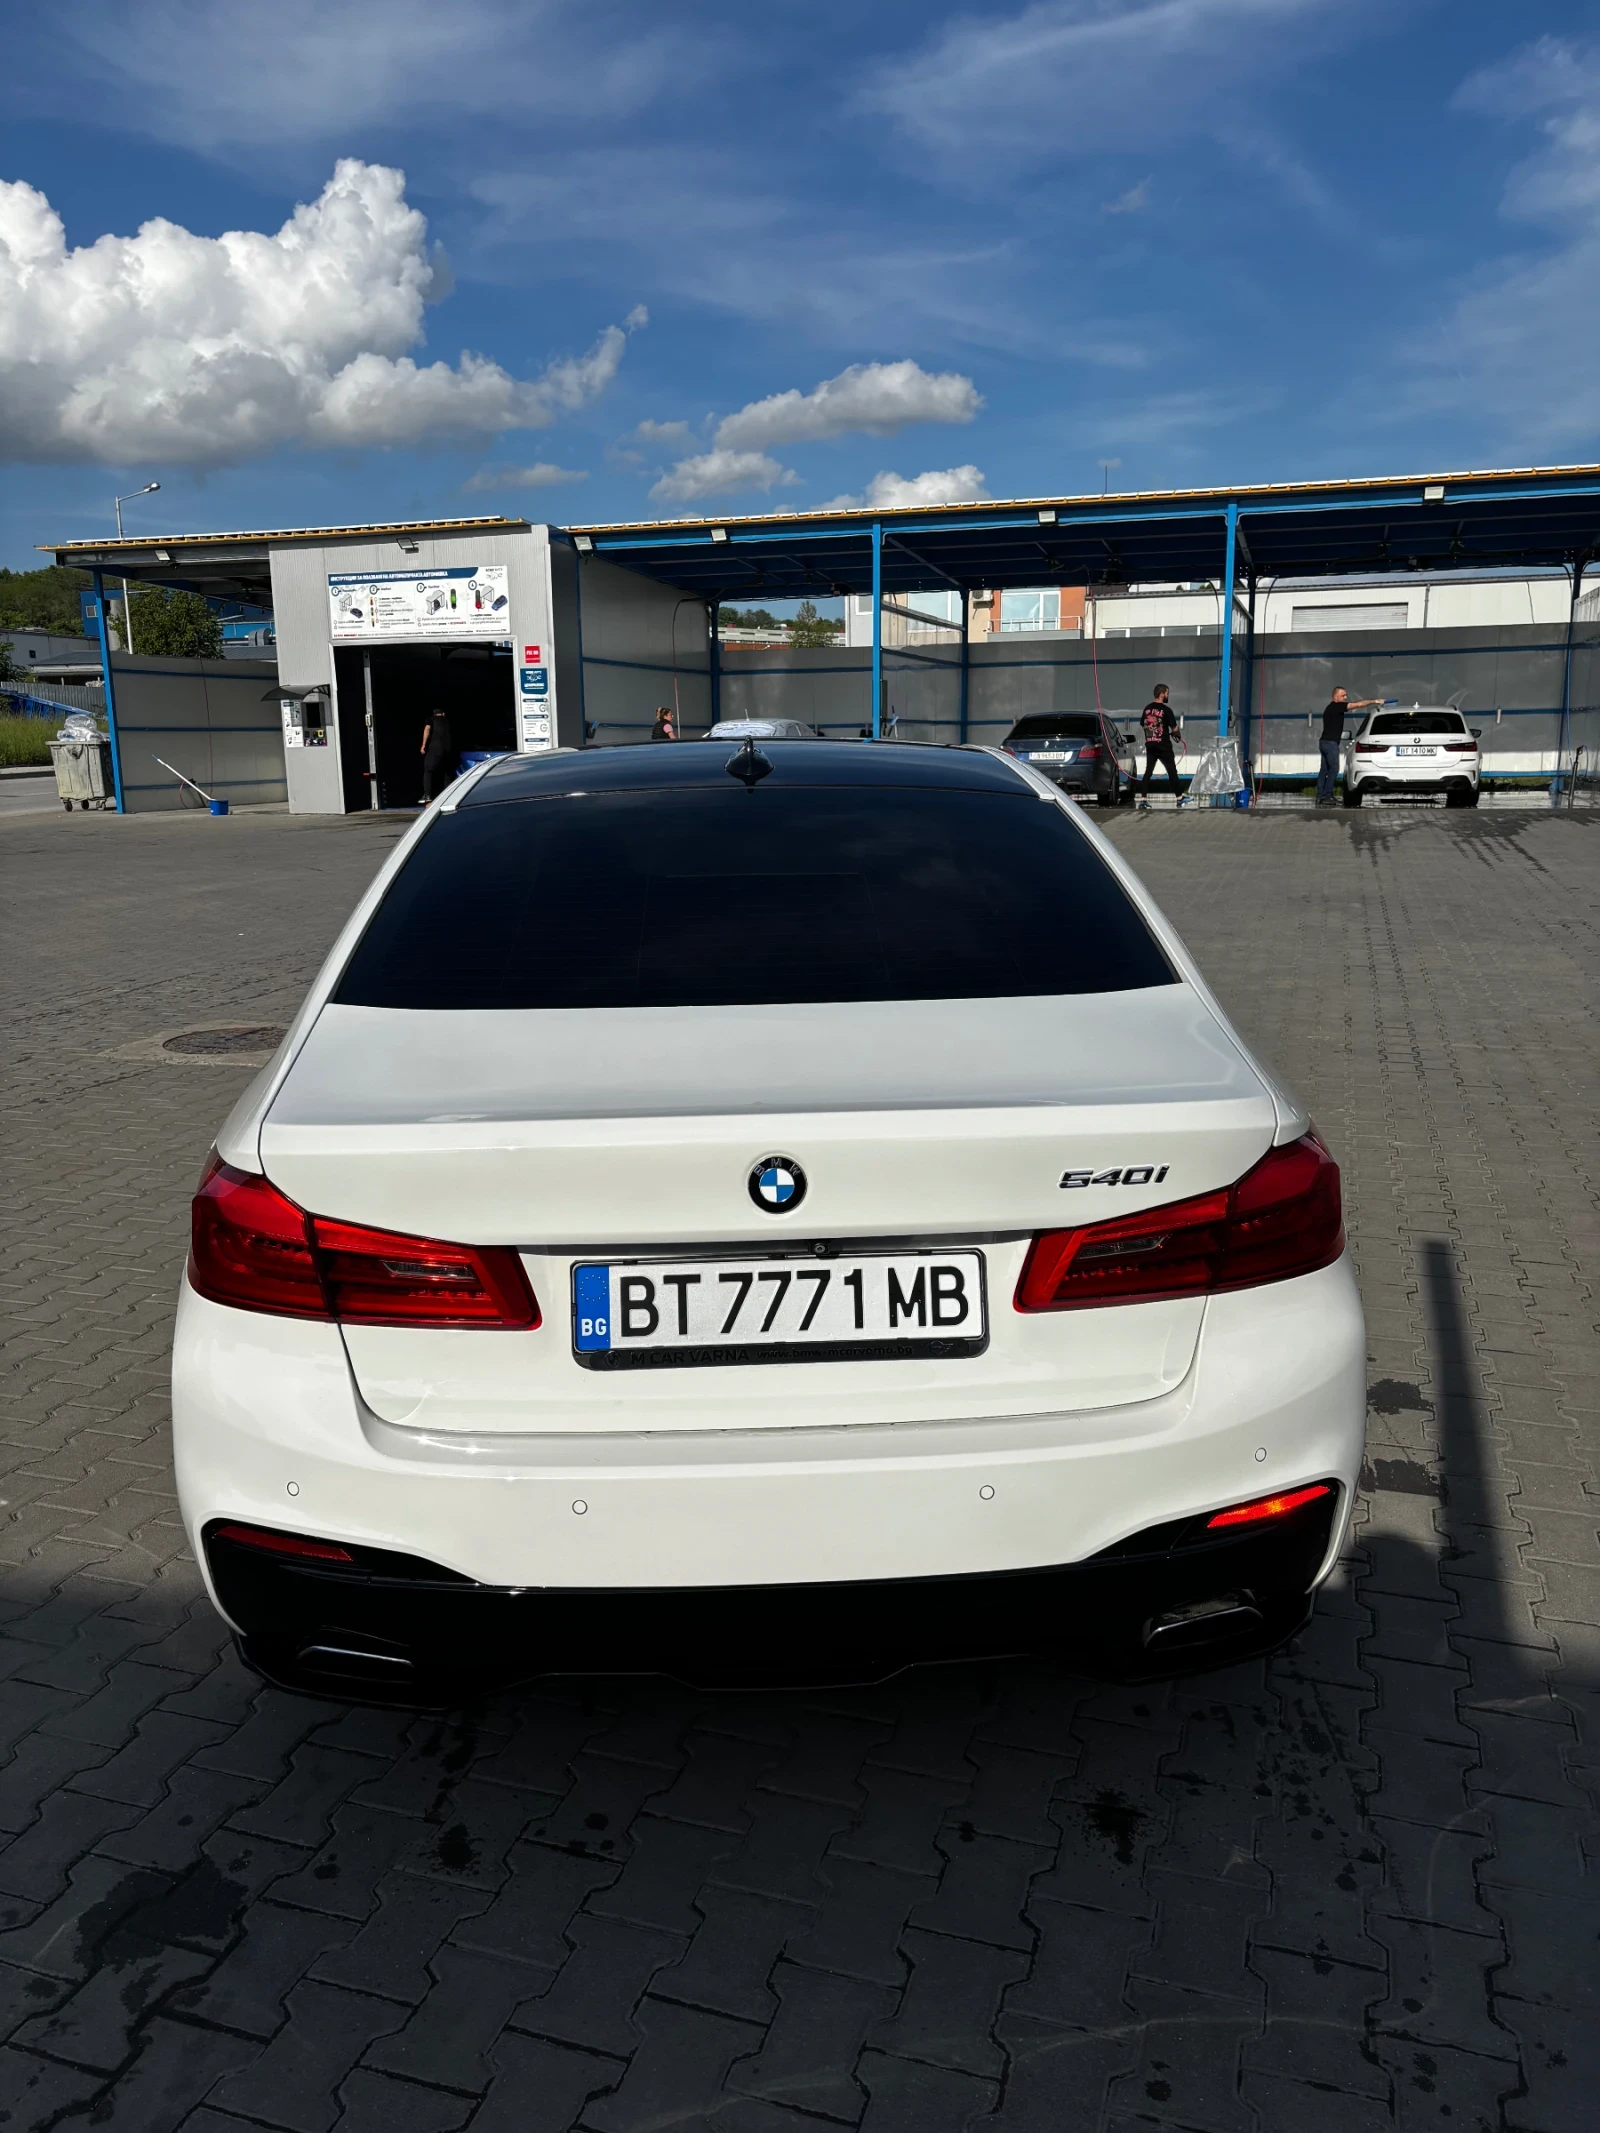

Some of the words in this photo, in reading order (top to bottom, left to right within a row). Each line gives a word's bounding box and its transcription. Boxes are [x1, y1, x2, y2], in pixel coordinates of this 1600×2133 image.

[753, 1157, 802, 1177] BMW
[1058, 1163, 1170, 1189] 540i
[619, 1273, 701, 1338] BT
[718, 1268, 864, 1334] 7771
[887, 1265, 969, 1329] MB
[581, 1317, 607, 1337] BG
[630, 1352, 645, 1365] M
[649, 1351, 685, 1365] CAR
[689, 1348, 750, 1363] VARNA
